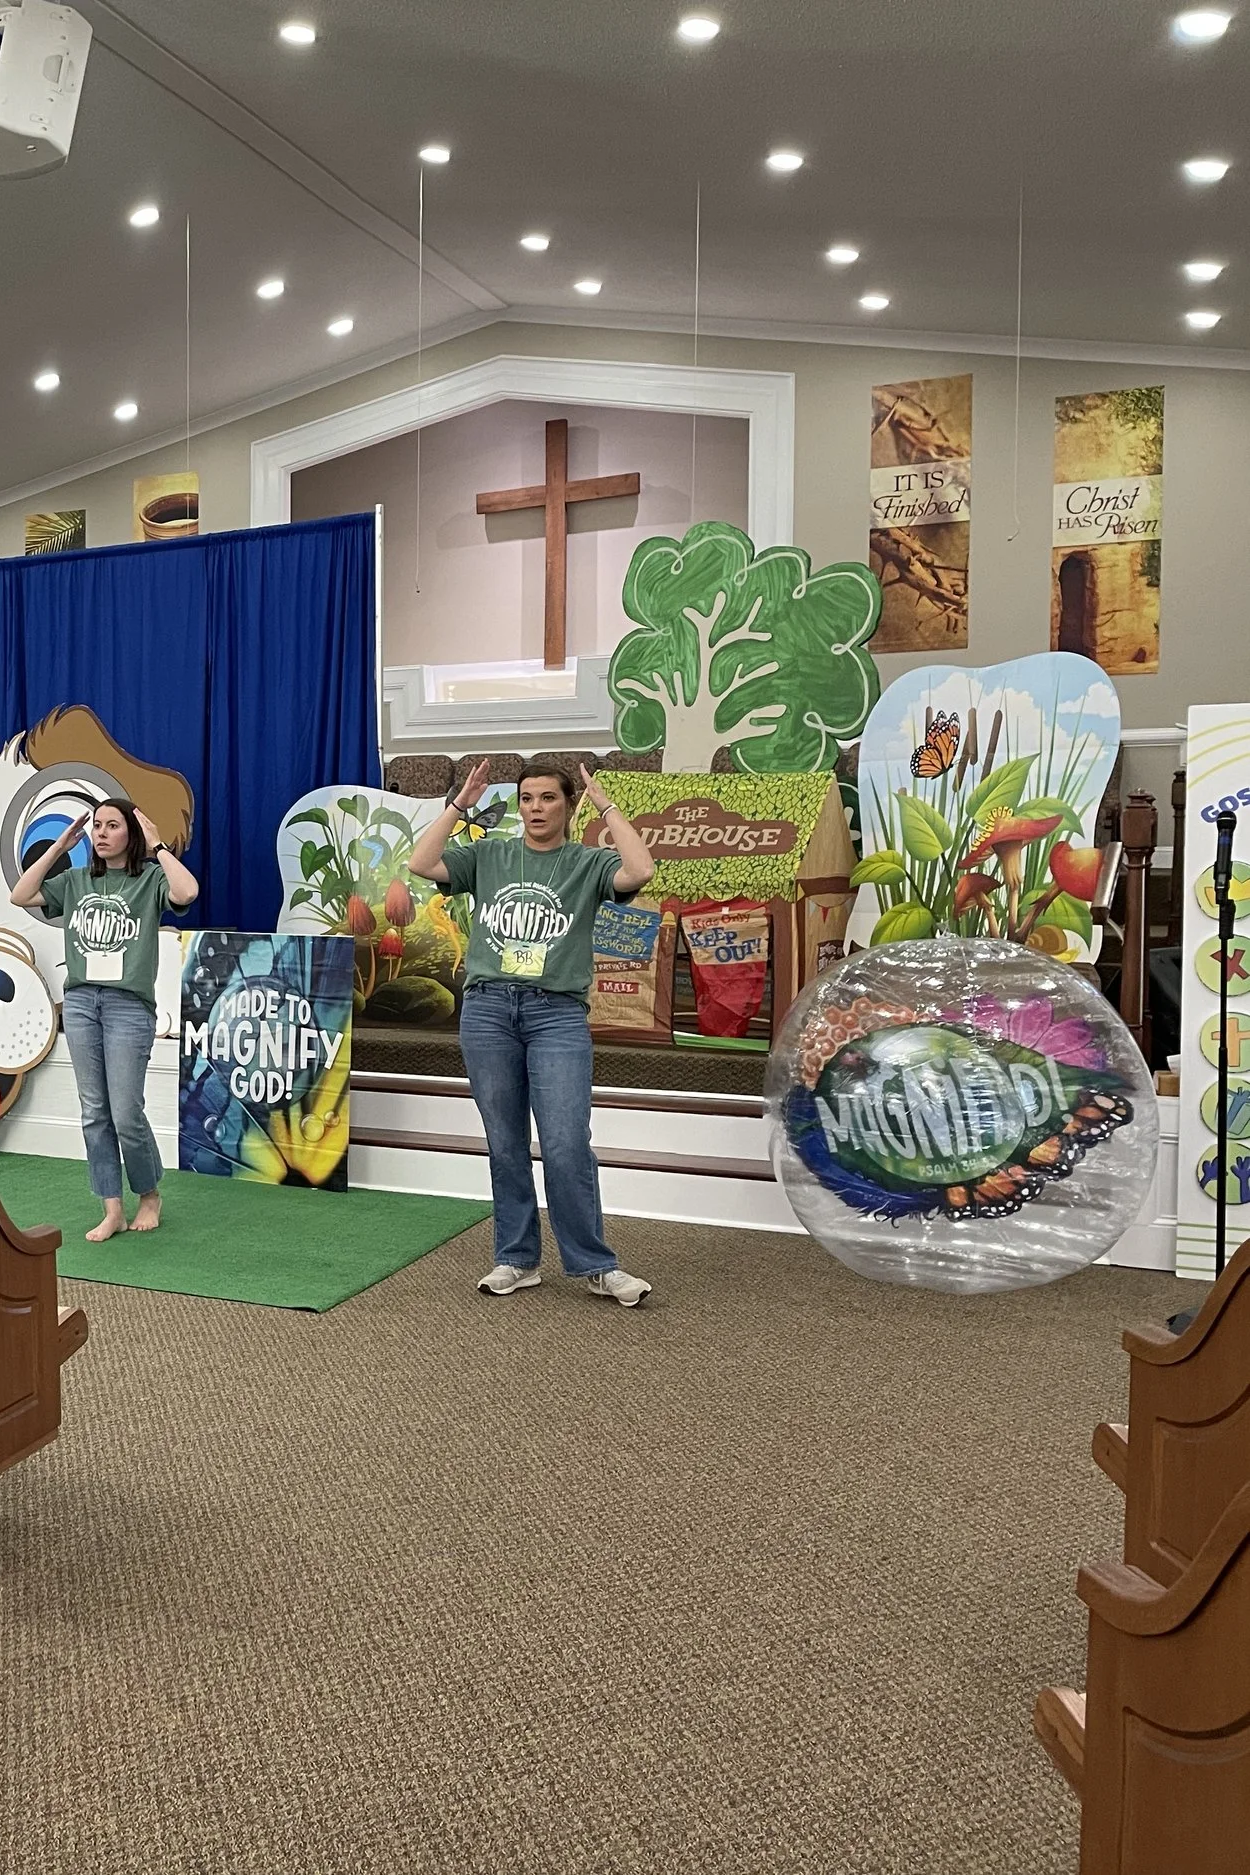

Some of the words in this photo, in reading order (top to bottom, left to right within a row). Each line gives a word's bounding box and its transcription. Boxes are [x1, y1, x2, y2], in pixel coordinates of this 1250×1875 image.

[893, 473, 918, 493] IT
[922, 470, 945, 490] IS
[873, 489, 966, 522] Finished
[1065, 486, 1141, 515] Christ
[1057, 515, 1093, 531] HAS
[1094, 512, 1158, 540] Risen
[674, 806, 709, 822] THE
[598, 825, 781, 852] CUBHOUSE
[597, 905, 618, 922] ING
[622, 913, 653, 929] BELL
[691, 917, 720, 930] Kids
[721, 913, 751, 924] Only
[592, 935, 648, 957] SSWORD!
[687, 927, 738, 948] KEEP
[714, 938, 762, 963] OUT!
[598, 961, 628, 971] PRIVATE
[629, 961, 642, 969] RD
[602, 982, 635, 993] MAIL
[219, 989, 281, 1021] MADE
[284, 993, 312, 1025] TO
[184, 1020, 345, 1070] MAGNIFY
[230, 1066, 294, 1104] GOD!
[918, 1161, 959, 1177] PSALM
